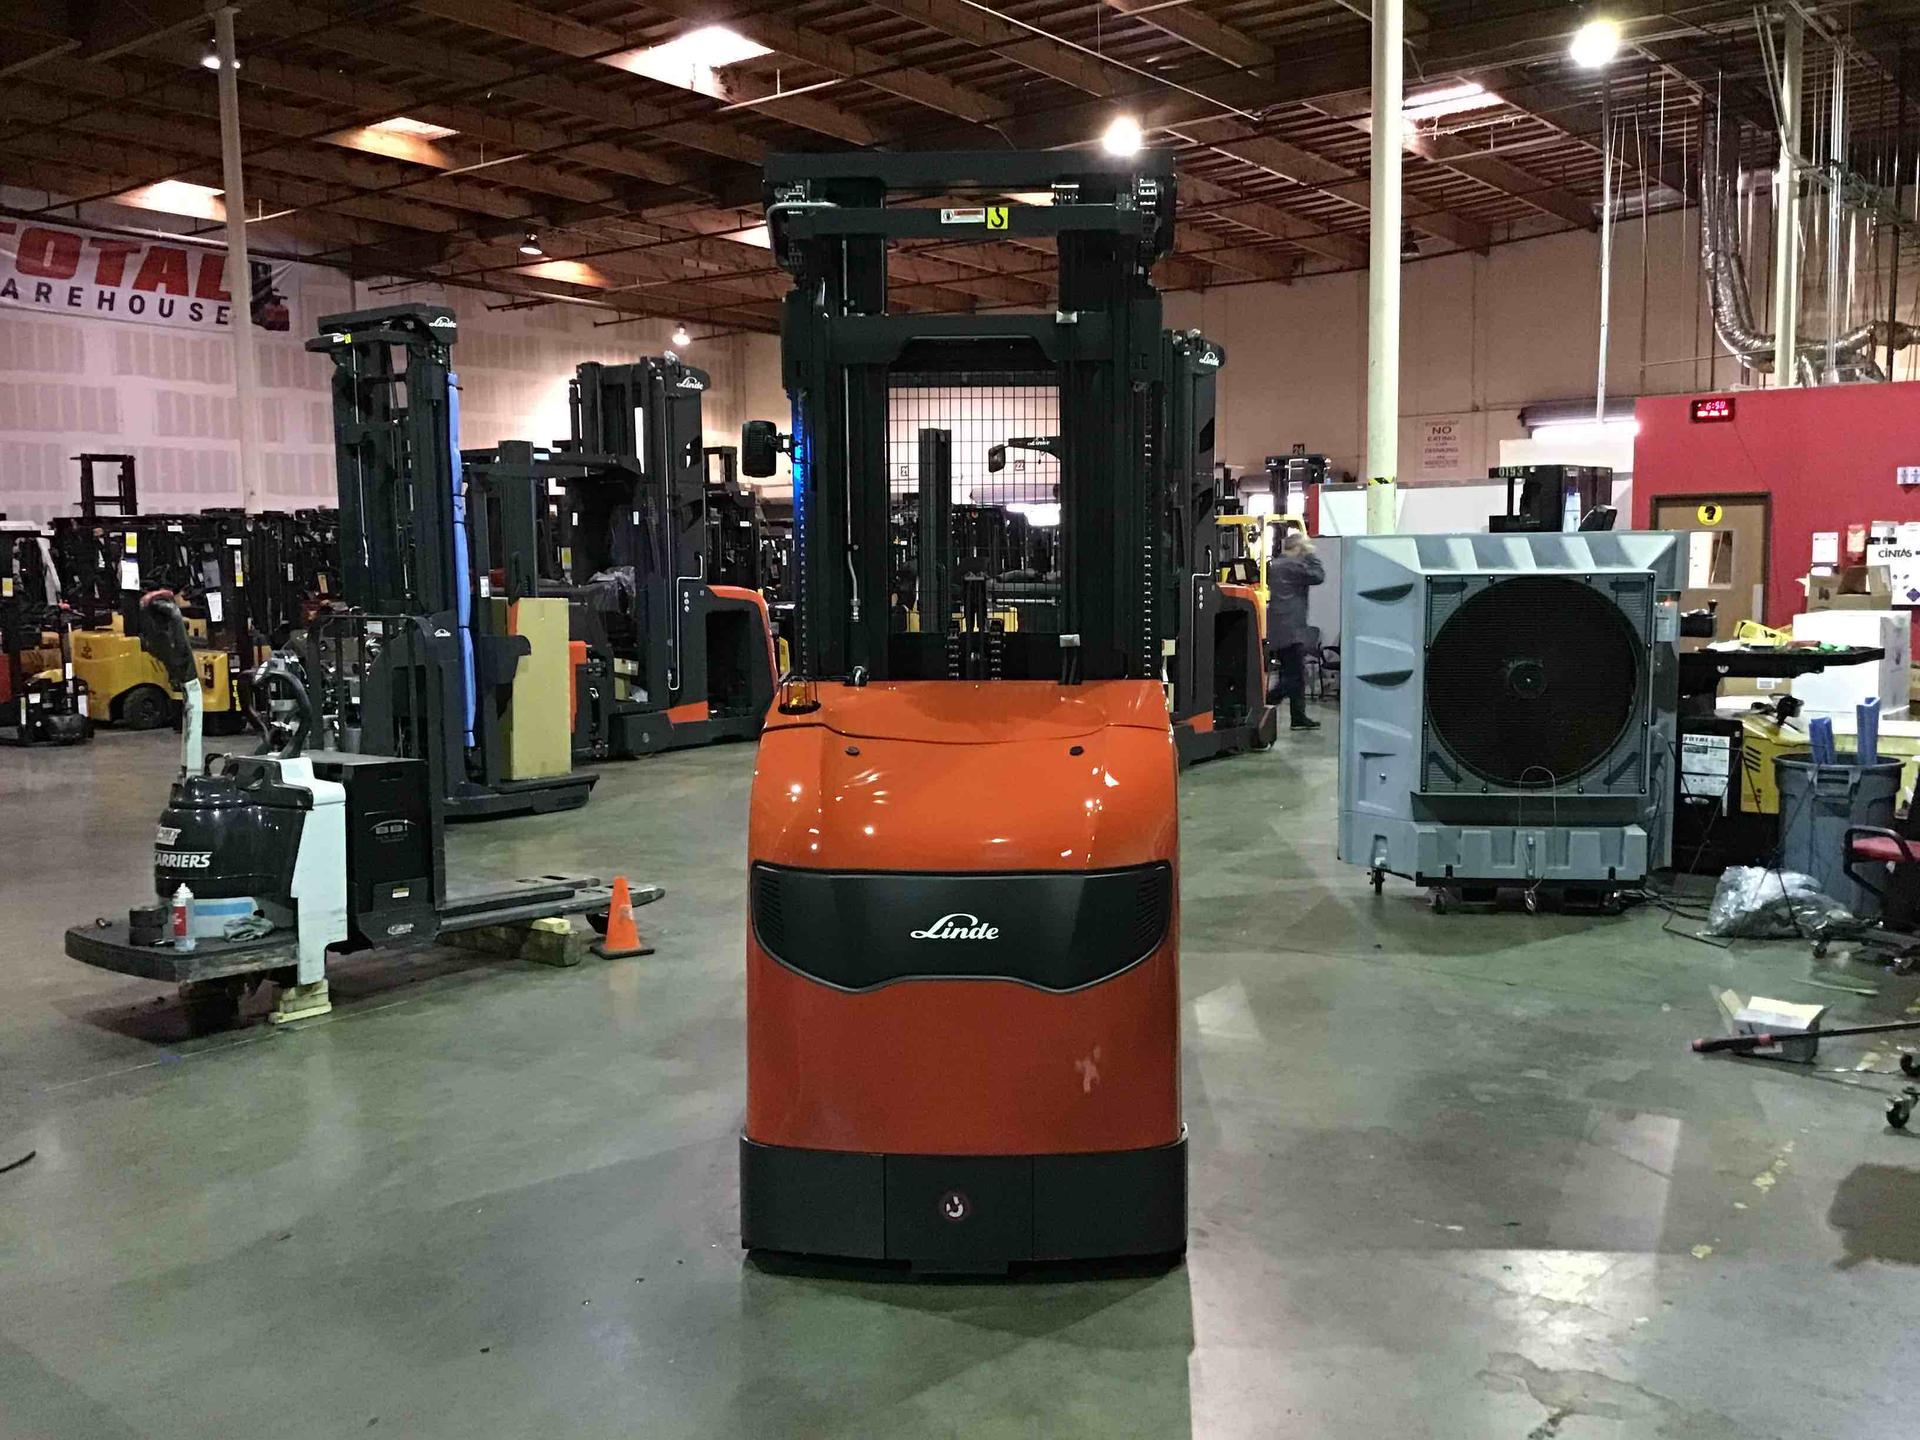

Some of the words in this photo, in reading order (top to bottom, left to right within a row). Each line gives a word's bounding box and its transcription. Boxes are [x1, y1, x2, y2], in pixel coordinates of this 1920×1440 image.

[429, 316, 457, 328] Linde
[676, 376, 704, 390] Linde
[1432, 426, 1452, 434] NO
[910, 913, 1000, 940] Linde
